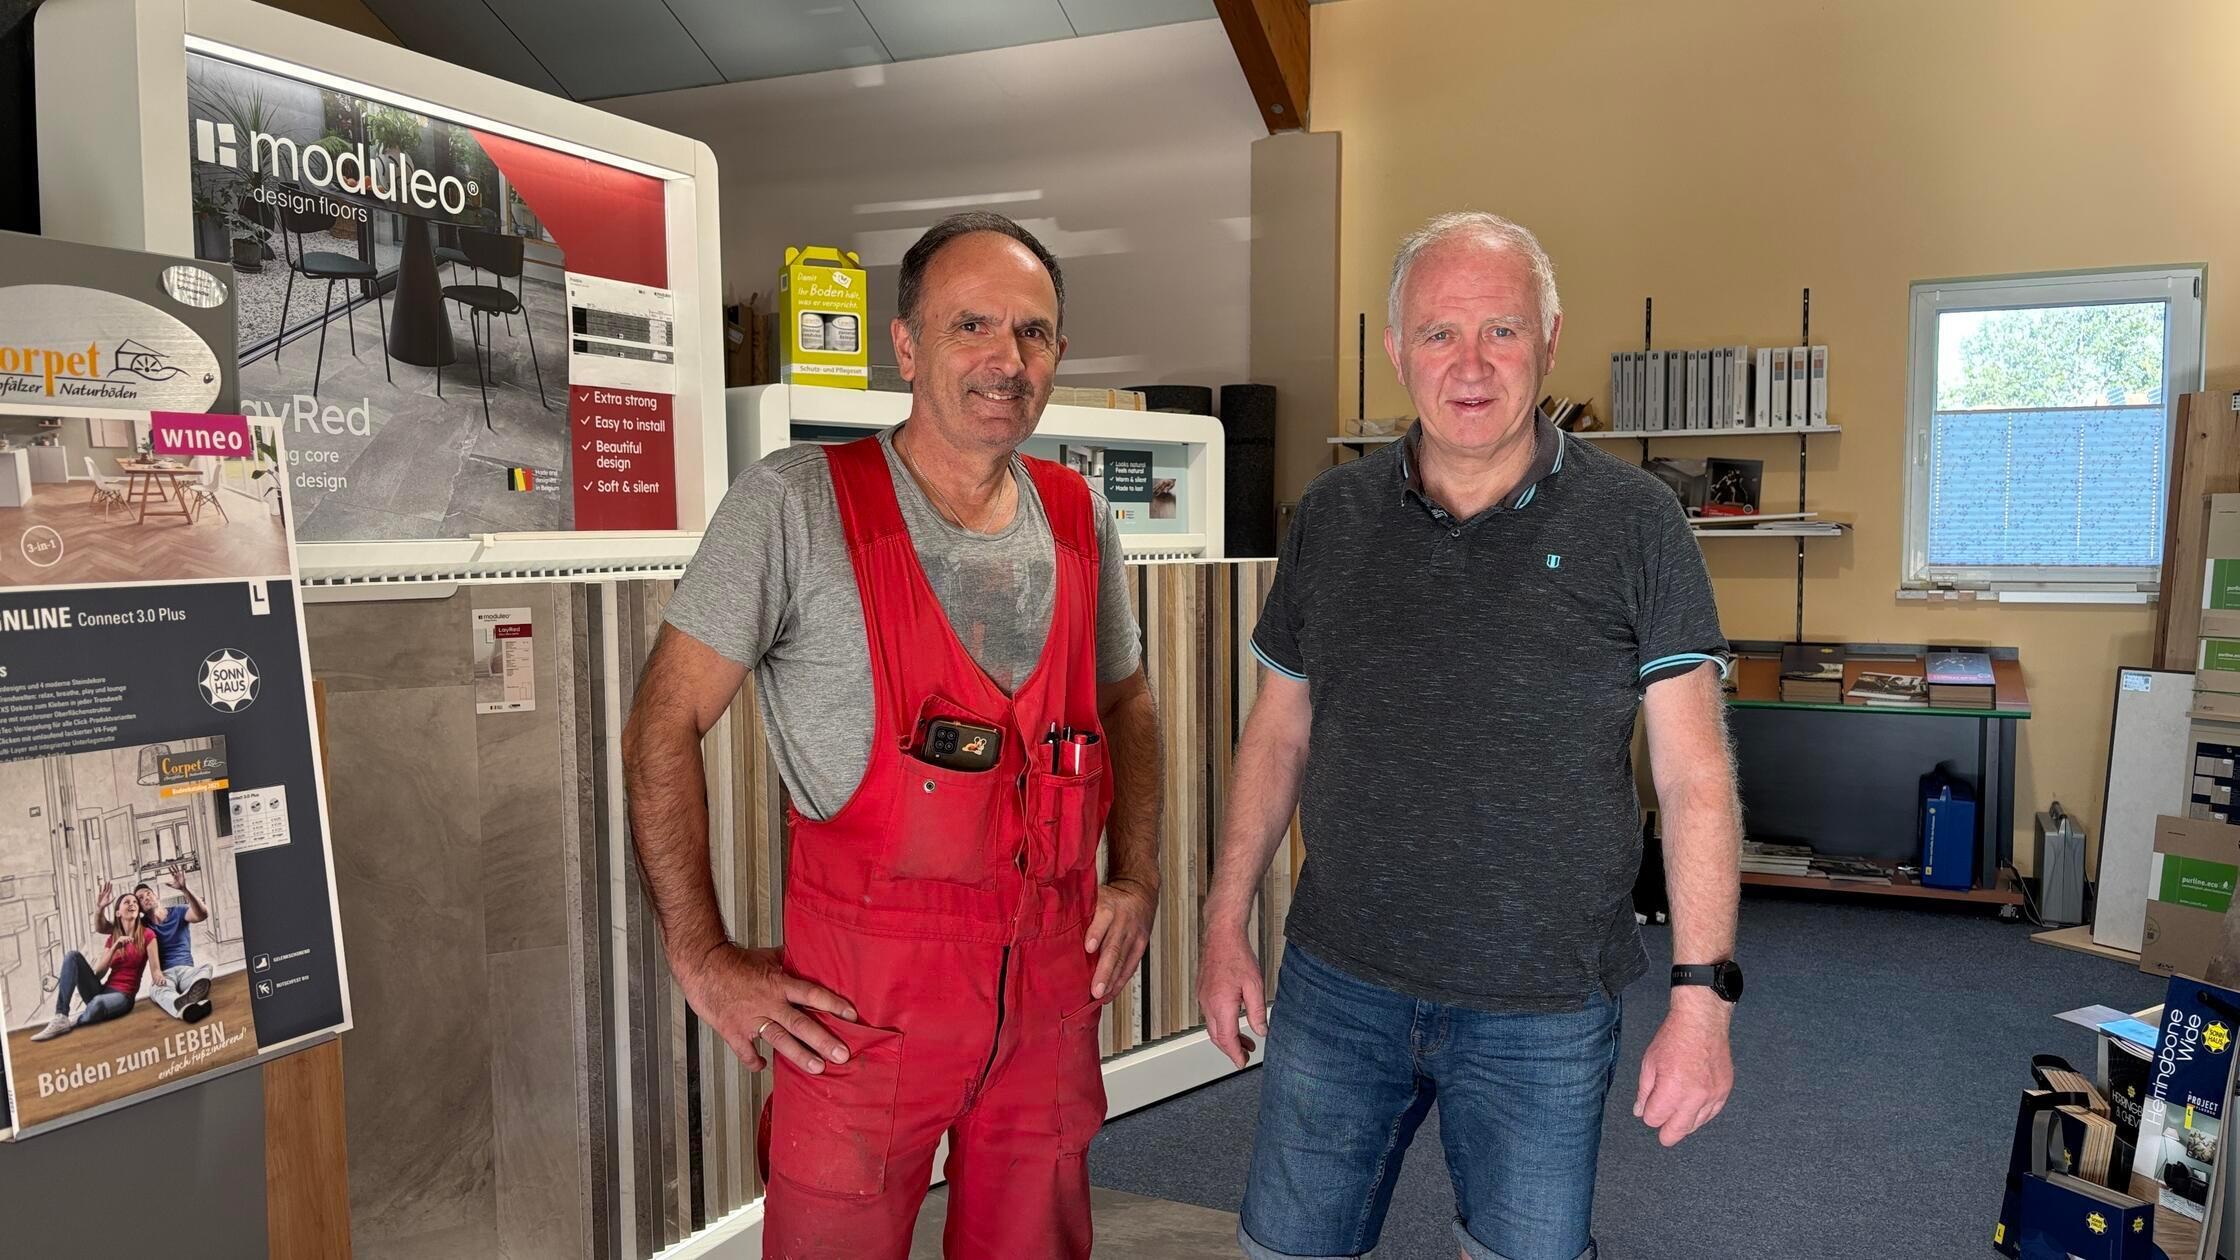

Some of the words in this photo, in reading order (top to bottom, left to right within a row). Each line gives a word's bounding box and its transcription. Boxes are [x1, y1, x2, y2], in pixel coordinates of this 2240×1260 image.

[253, 184, 316, 215] design
[319, 196, 368, 223] floors
[797, 271, 817, 281] Damit
[798, 287, 809, 296] Ihr
[809, 284, 845, 298] Boden
[0, 340, 101, 398] orpet
[0, 375, 43, 397] fälzer
[59, 382, 138, 399] Naturböden
[594, 390, 622, 405] Extra
[624, 394, 657, 411] strong
[240, 394, 371, 437] ayRed
[595, 415, 620, 433] Easy
[622, 418, 634, 431] to
[636, 417, 666, 433] install
[160, 427, 243, 451] wineo
[596, 440, 643, 455] Beautiful
[304, 449, 340, 463] core
[596, 455, 631, 473] design
[295, 471, 348, 492] design
[597, 480, 619, 493] Soft
[622, 480, 631, 493] &
[633, 480, 660, 494] silent
[26, 538, 57, 554] 3-in-1
[0, 606, 73, 632] NLINE
[77, 611, 135, 627] Connect
[136, 608, 156, 624] 3.0
[158, 607, 187, 622] Plus
[213, 667, 245, 682] SONN
[27, 682, 40, 690] und
[45, 680, 71, 689] moderne
[214, 680, 246, 694] HAUS
[10, 704, 34, 712] Dekore
[48, 700, 70, 708] Kleben
[93, 694, 123, 703] Trendwelt
[161, 757, 202, 779] Corpet
[2176, 1014, 2202, 1061] Wide
[2208, 1035, 2224, 1046] HAUS
[2209, 1029, 2226, 1040] SONN
[37, 1060, 111, 1098] Böden
[116, 1043, 161, 1075] zum
[164, 1020, 227, 1060] LEBEN
[158, 1054, 191, 1080] einfach
[2145, 1008, 2184, 1126] Herringbone
[2112, 1089, 2144, 1117] HERRINGB
[2186, 1094, 2219, 1112] PROJECT
[2121, 1110, 2141, 1128] CHEV
